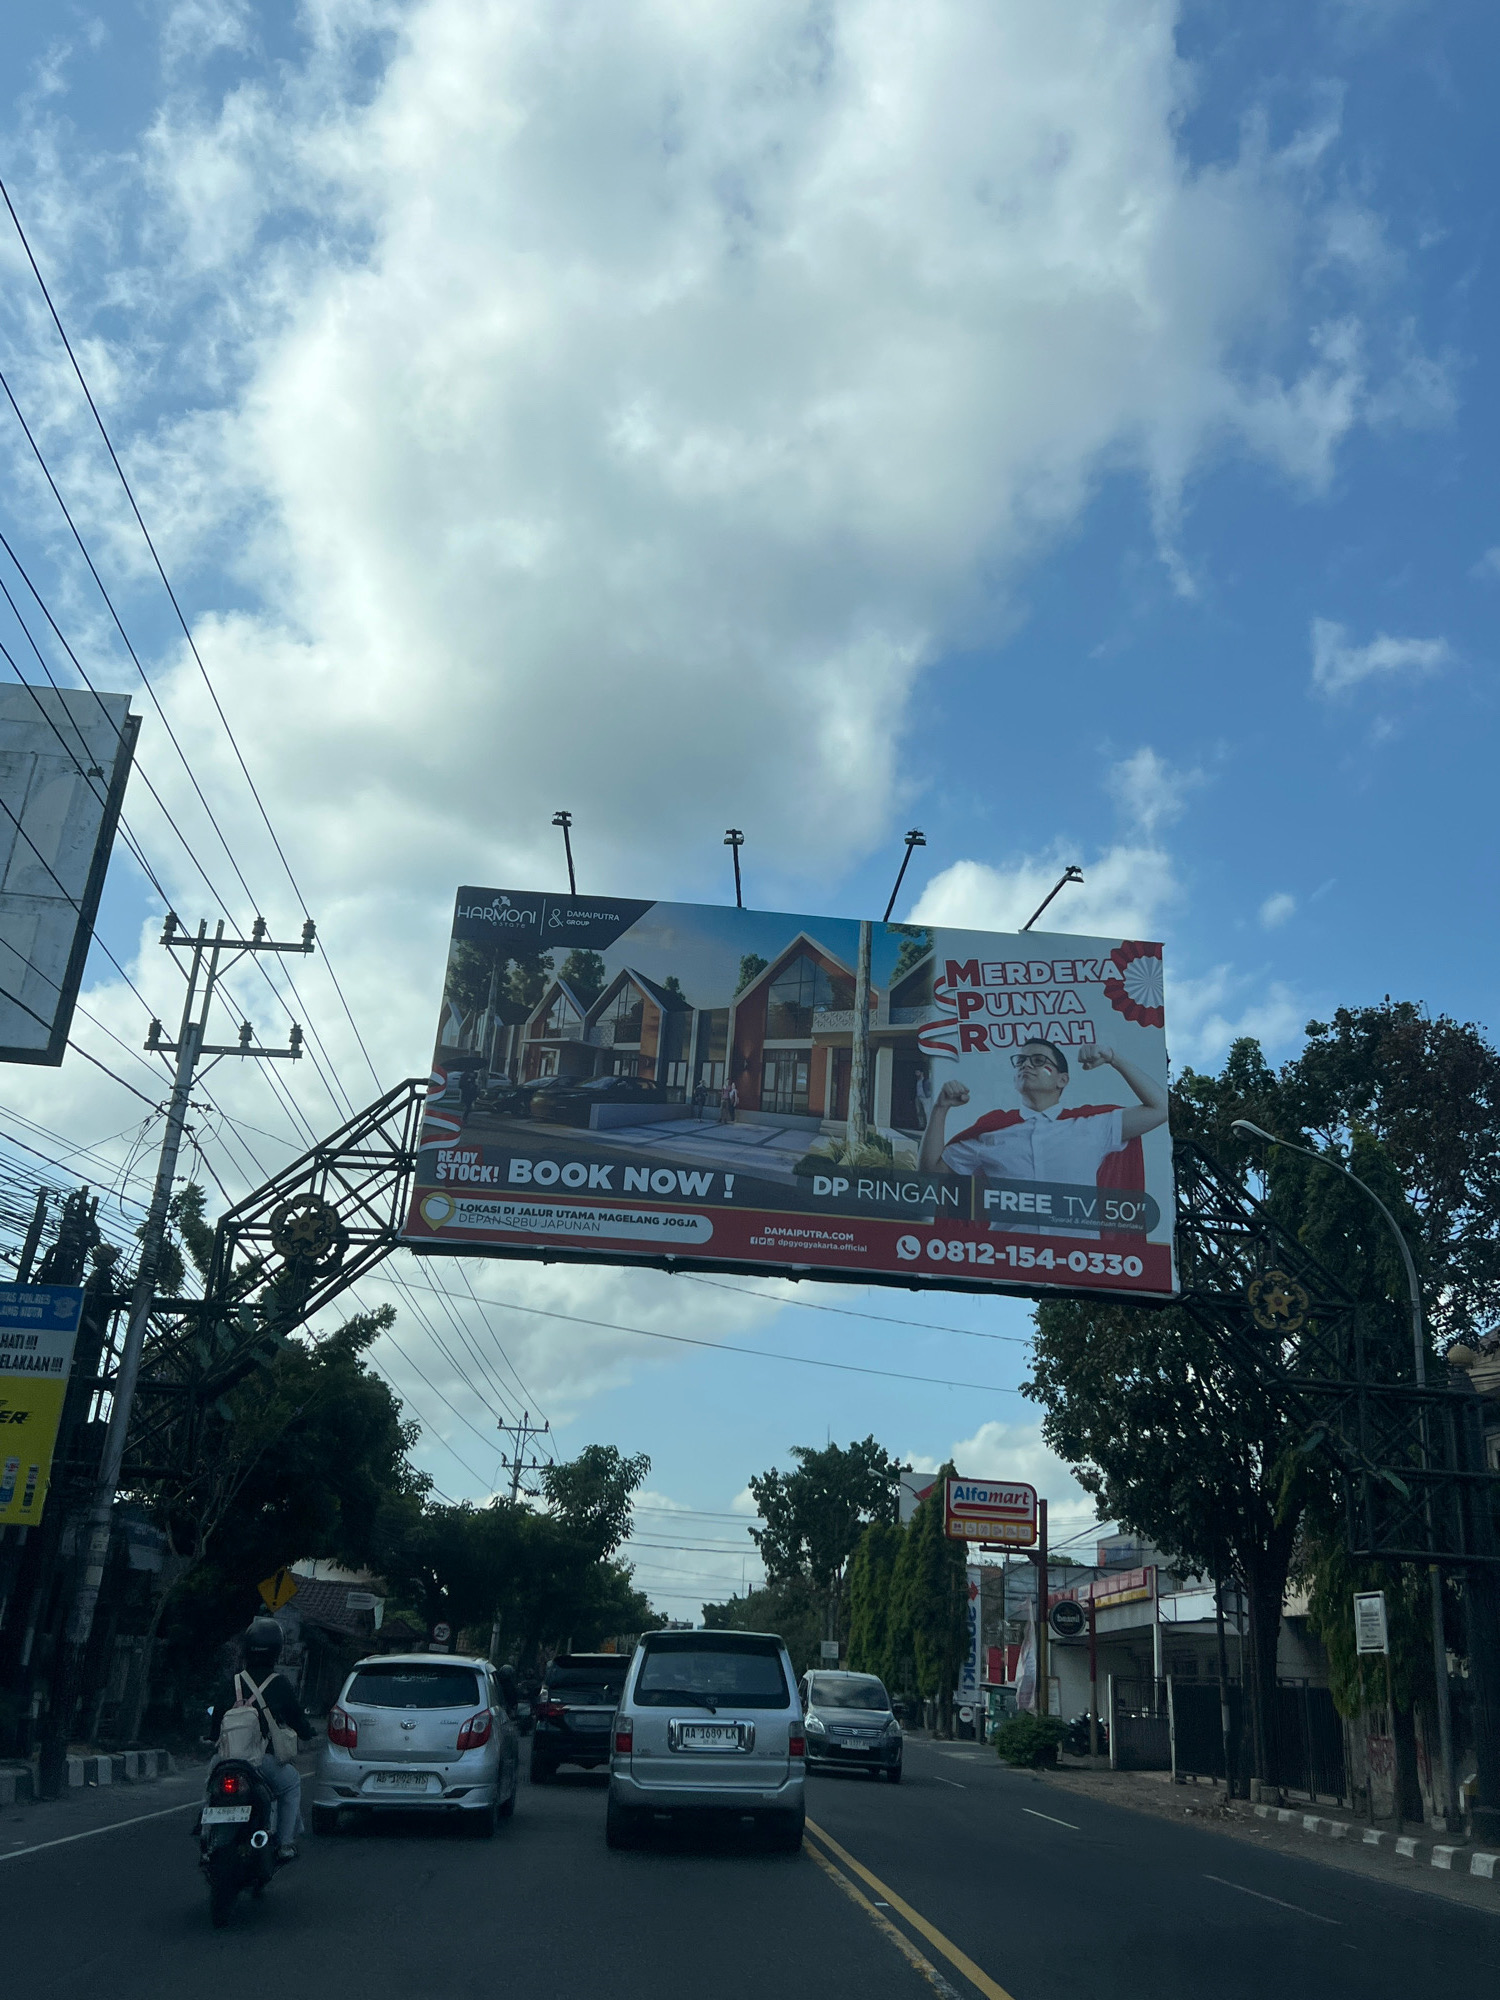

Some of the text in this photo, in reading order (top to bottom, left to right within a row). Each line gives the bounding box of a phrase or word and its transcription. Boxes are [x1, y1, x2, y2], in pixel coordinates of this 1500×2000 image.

[457, 904, 536, 924] HARMONI
[566, 919, 590, 927] GROUP
[945, 958, 1126, 988] MERDEKA
[956, 989, 1086, 1020] PUNYA
[959, 1020, 1096, 1053] RUMAH
[437, 1149, 479, 1164] READY
[435, 1162, 500, 1184] STOCK!
[507, 1158, 615, 1190] BOOK
[623, 1166, 715, 1197] NOW
[812, 1175, 959, 1206] DP RINGAN
[983, 1189, 1052, 1214] FREE
[1063, 1195, 1097, 1218] TV
[458, 1213, 600, 1232] DEPAN SPBU JAPUNAN
[459, 1203, 699, 1228] LOKASI DI JALUR UTAMA MAGELANG JOGJA
[764, 1226, 854, 1241] DAMAIPUTRA.COM
[777, 1238, 868, 1252] dpgyogyakarta.official
[926, 1238, 1143, 1277] 0812-154-0330
[953, 1485, 1030, 1505] Alfamart
[700, 1728, 722, 1739] 1689
